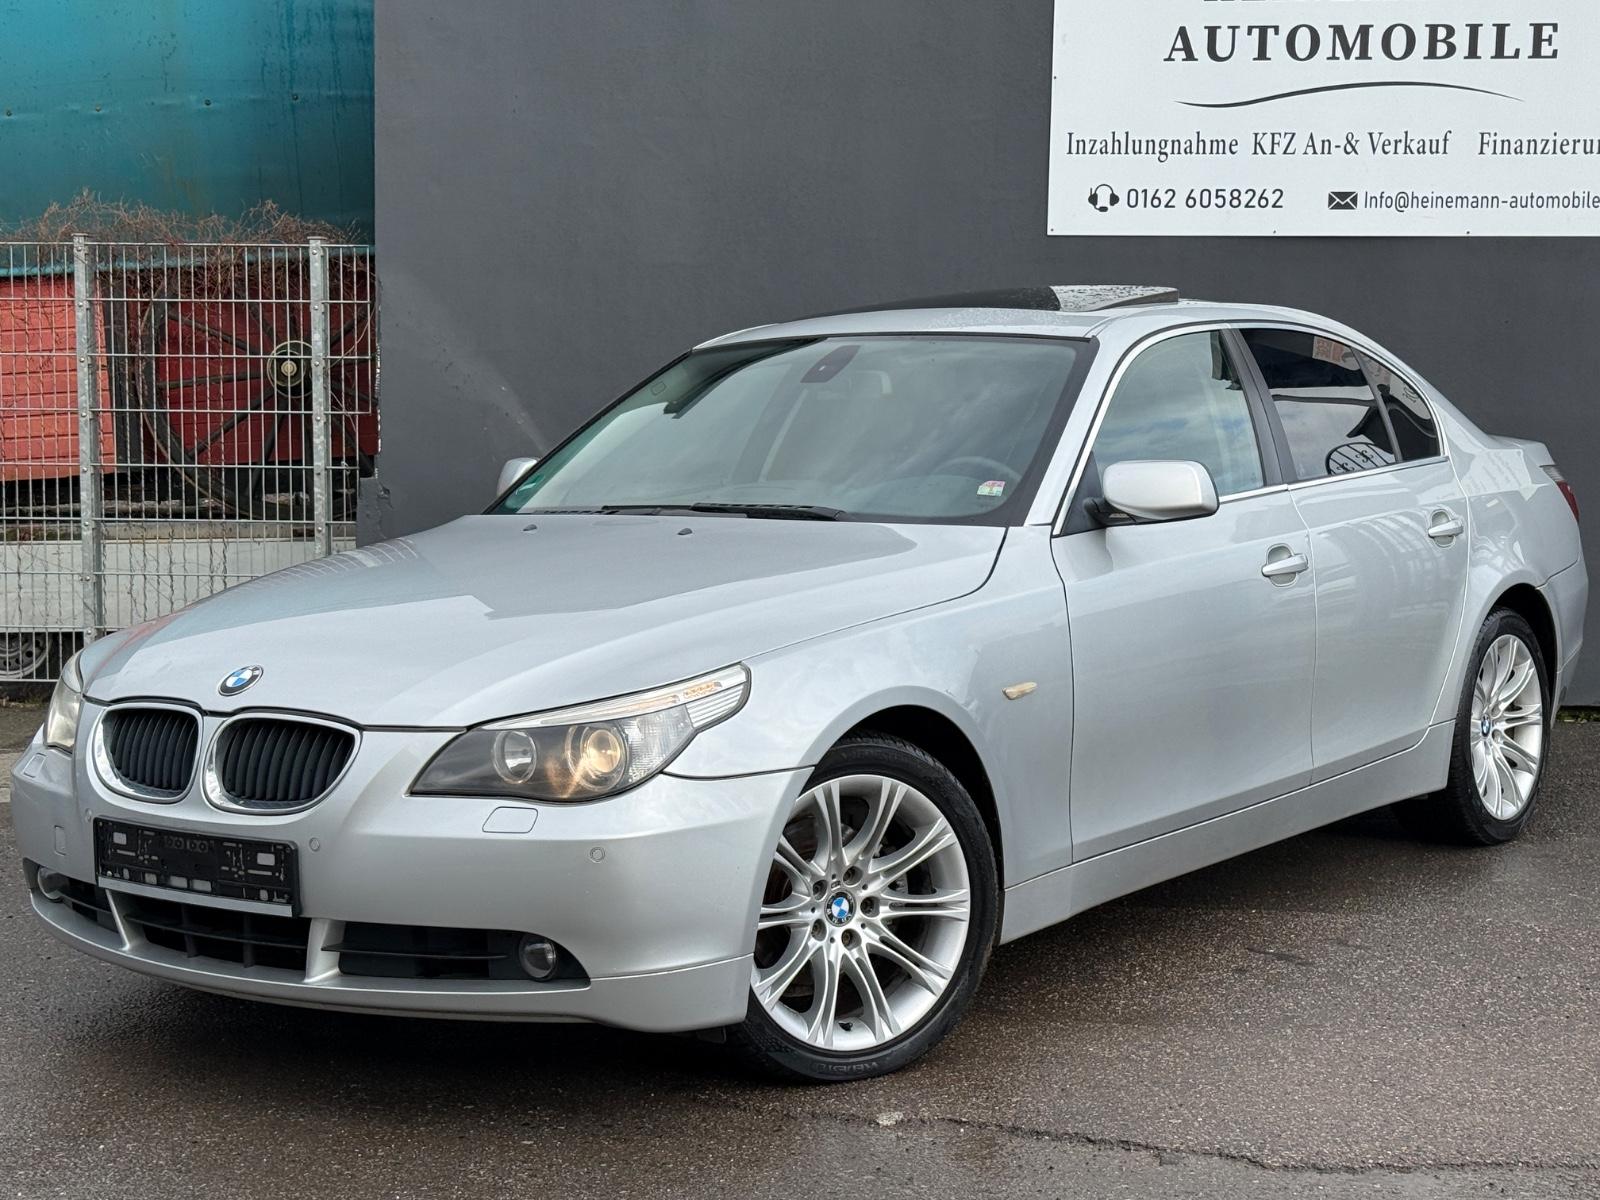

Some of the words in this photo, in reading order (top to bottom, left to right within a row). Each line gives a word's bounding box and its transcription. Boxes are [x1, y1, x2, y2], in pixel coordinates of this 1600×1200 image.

[1164, 23, 1558, 62] AUTOMOBILE
[1066, 131, 1239, 163] Inzahlungnahme
[1252, 132, 1297, 155] KFZ
[1367, 130, 1453, 156] Verkauf
[1126, 188, 1177, 209] 0162
[1185, 188, 1284, 209] 6058262
